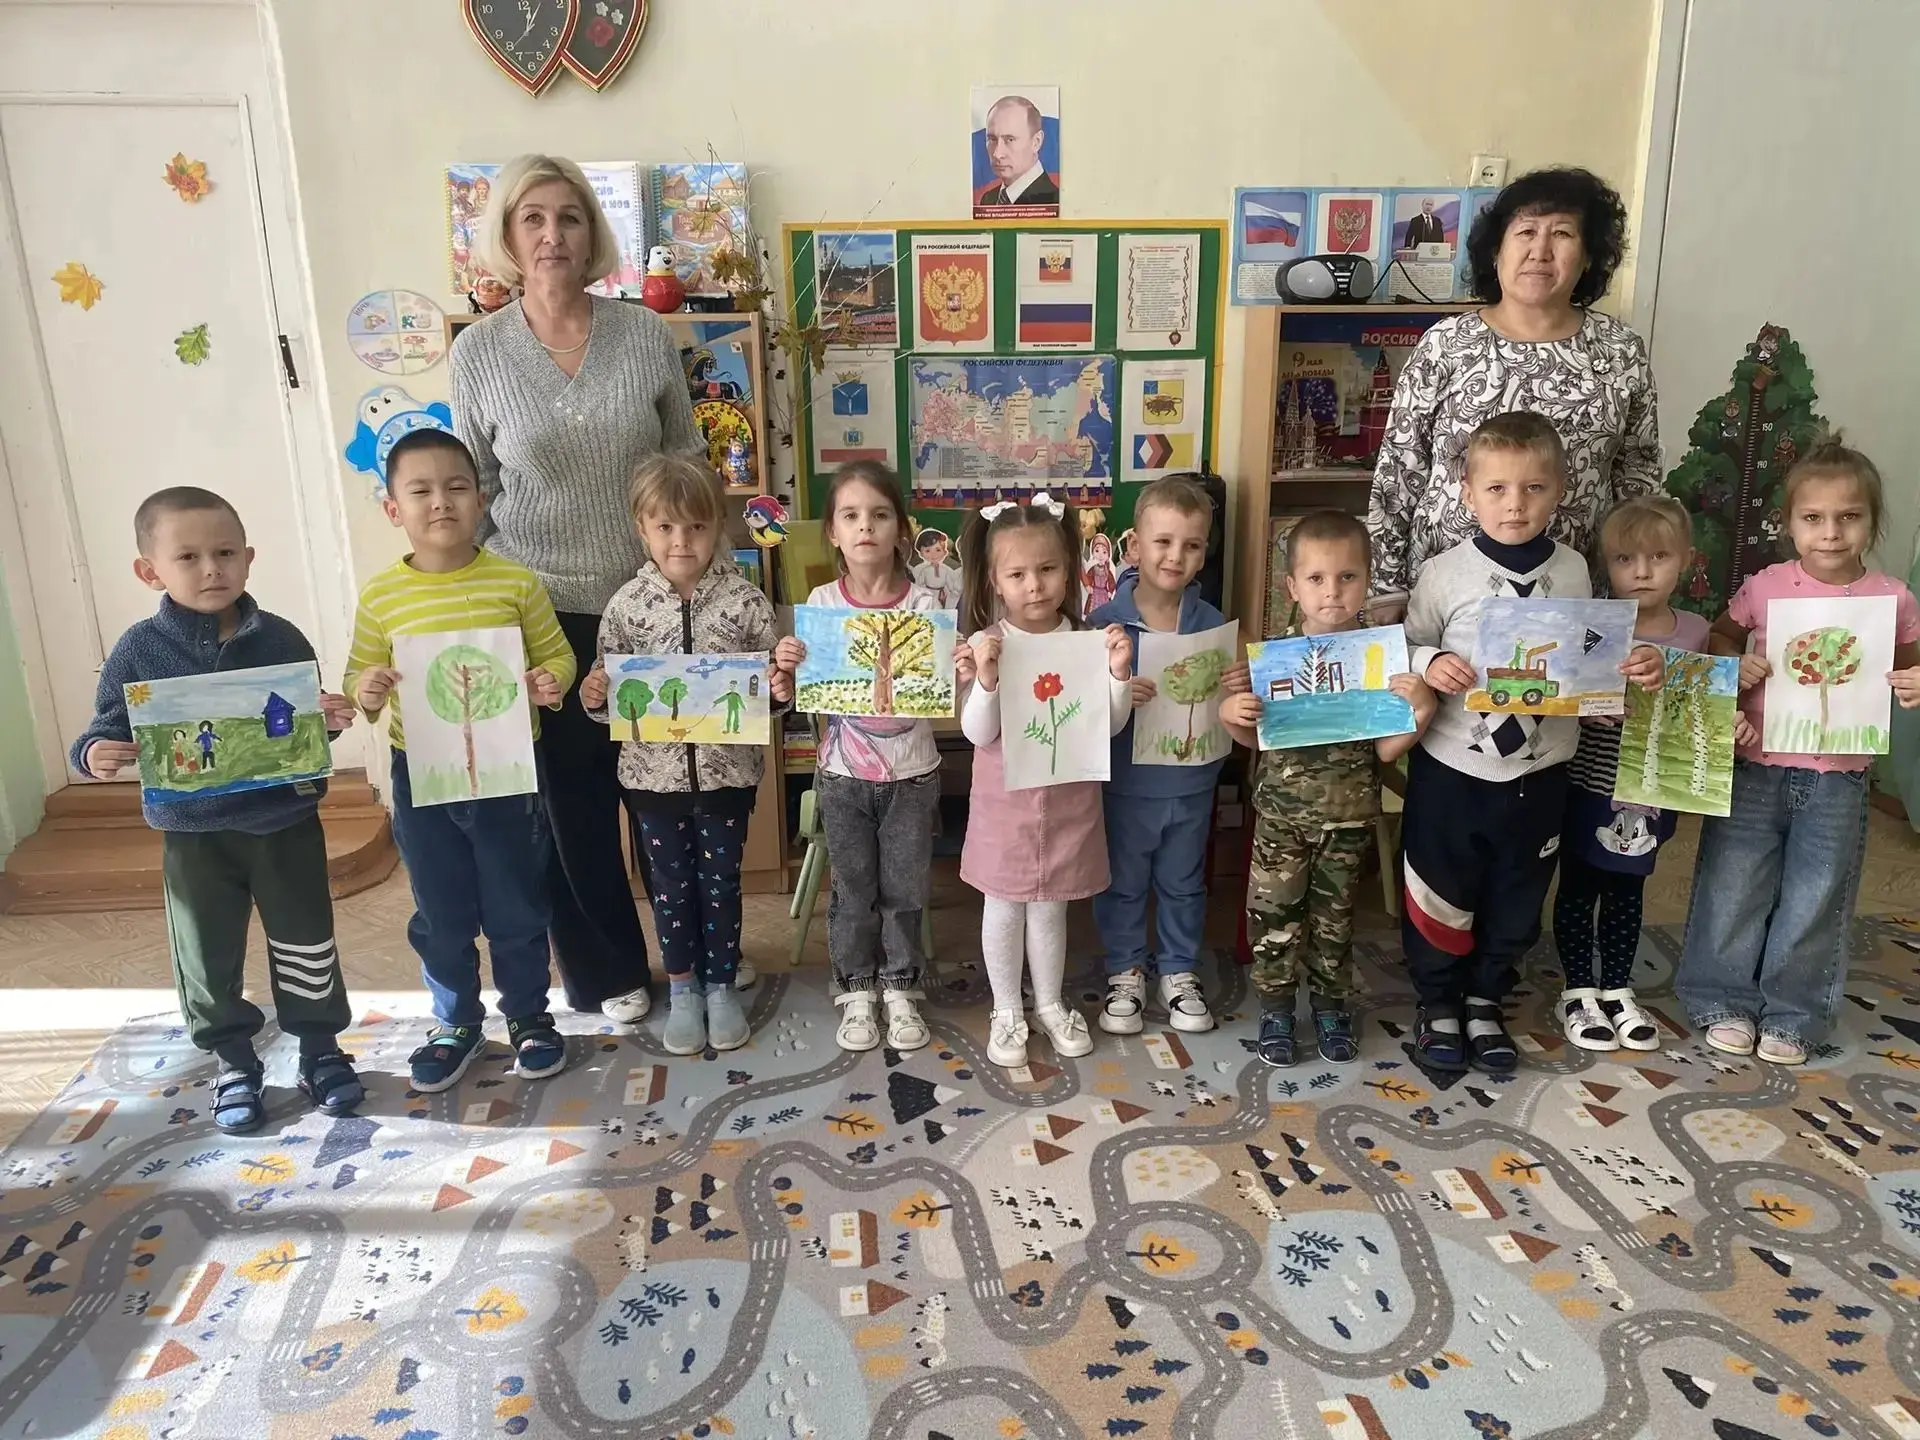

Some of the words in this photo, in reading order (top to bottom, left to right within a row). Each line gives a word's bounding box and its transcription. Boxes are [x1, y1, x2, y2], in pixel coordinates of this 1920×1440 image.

[482, 4, 493, 14] 10
[518, 1, 529, 11] 12
[494, 29, 504, 40] 9
[550, 26, 559, 37] 3
[505, 41, 515, 52] 8
[542, 39, 551, 49] 4
[515, 51, 523, 61] 7
[535, 51, 544, 61] 5
[527, 61, 536, 72] 6
[1361, 332, 1418, 345] РОССИЯ
[963, 359, 1015, 368] РОССИЙСКАЯ
[1015, 359, 1064, 367] ФЕДЕРАЦИЯ
[1292, 351, 1305, 369] 9
[1762, 422, 1773, 432] 150
[1756, 460, 1767, 470] 140
[1752, 498, 1763, 507] 130
[1747, 535, 1758, 545] 120
